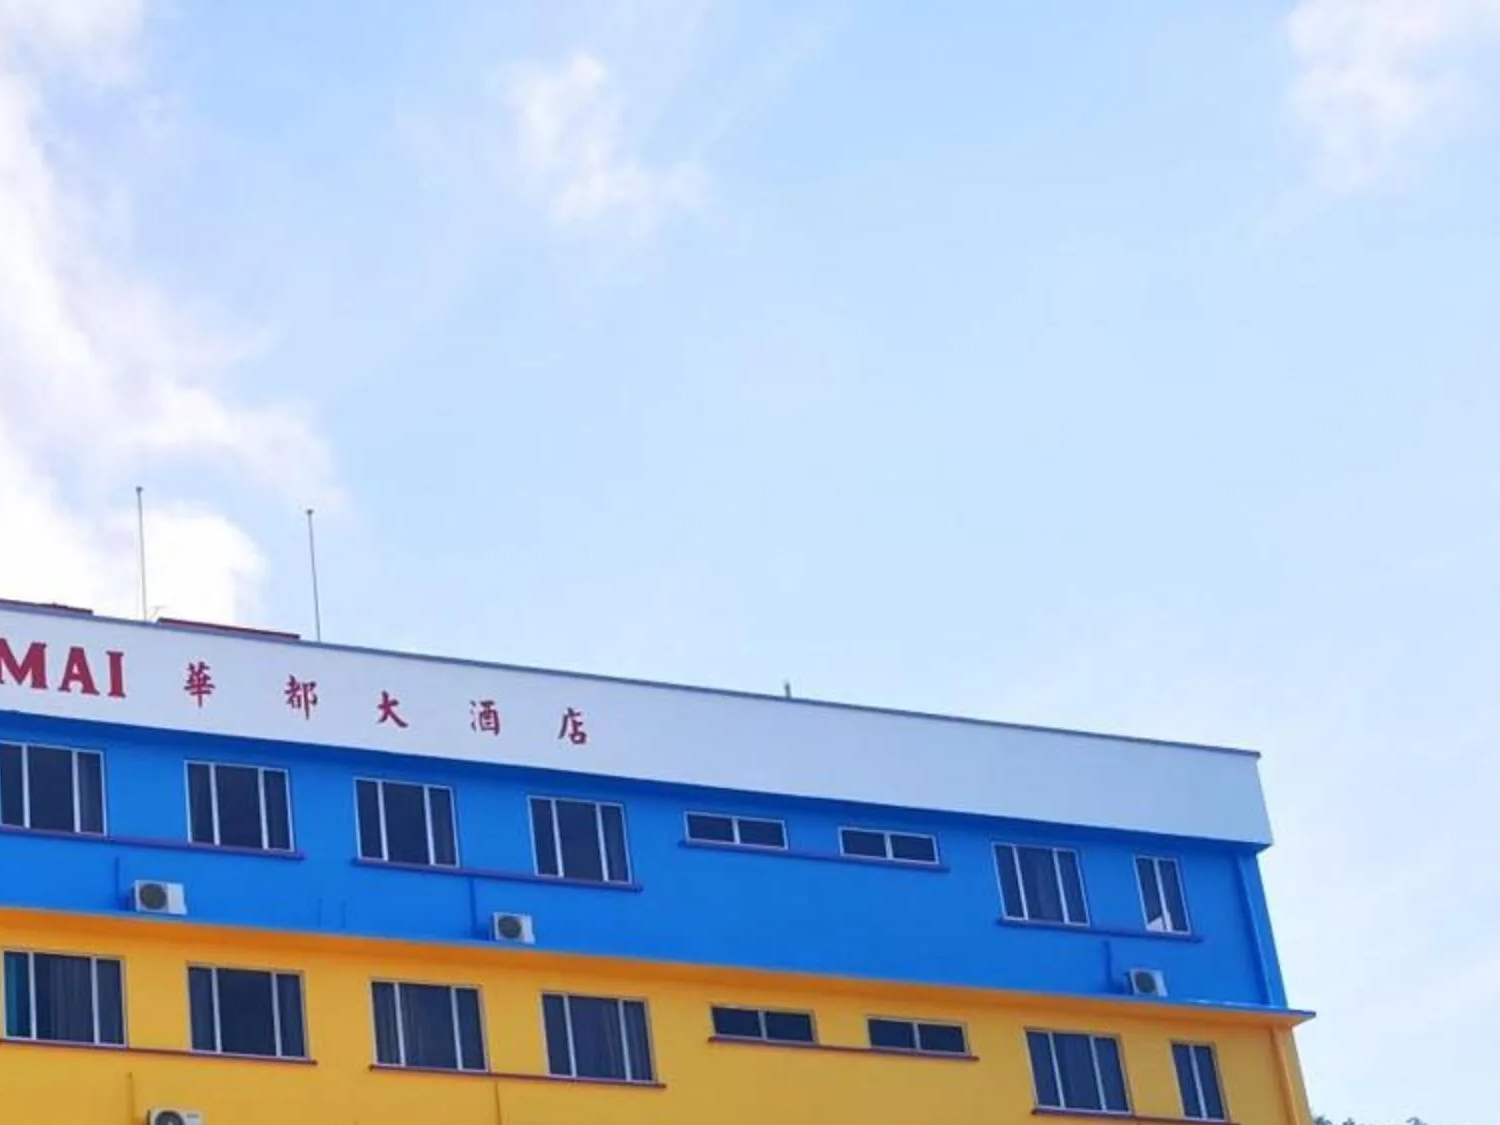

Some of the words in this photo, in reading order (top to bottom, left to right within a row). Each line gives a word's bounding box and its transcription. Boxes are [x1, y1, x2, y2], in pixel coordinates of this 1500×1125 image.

[183, 661, 588, 746] 華都大酒店
